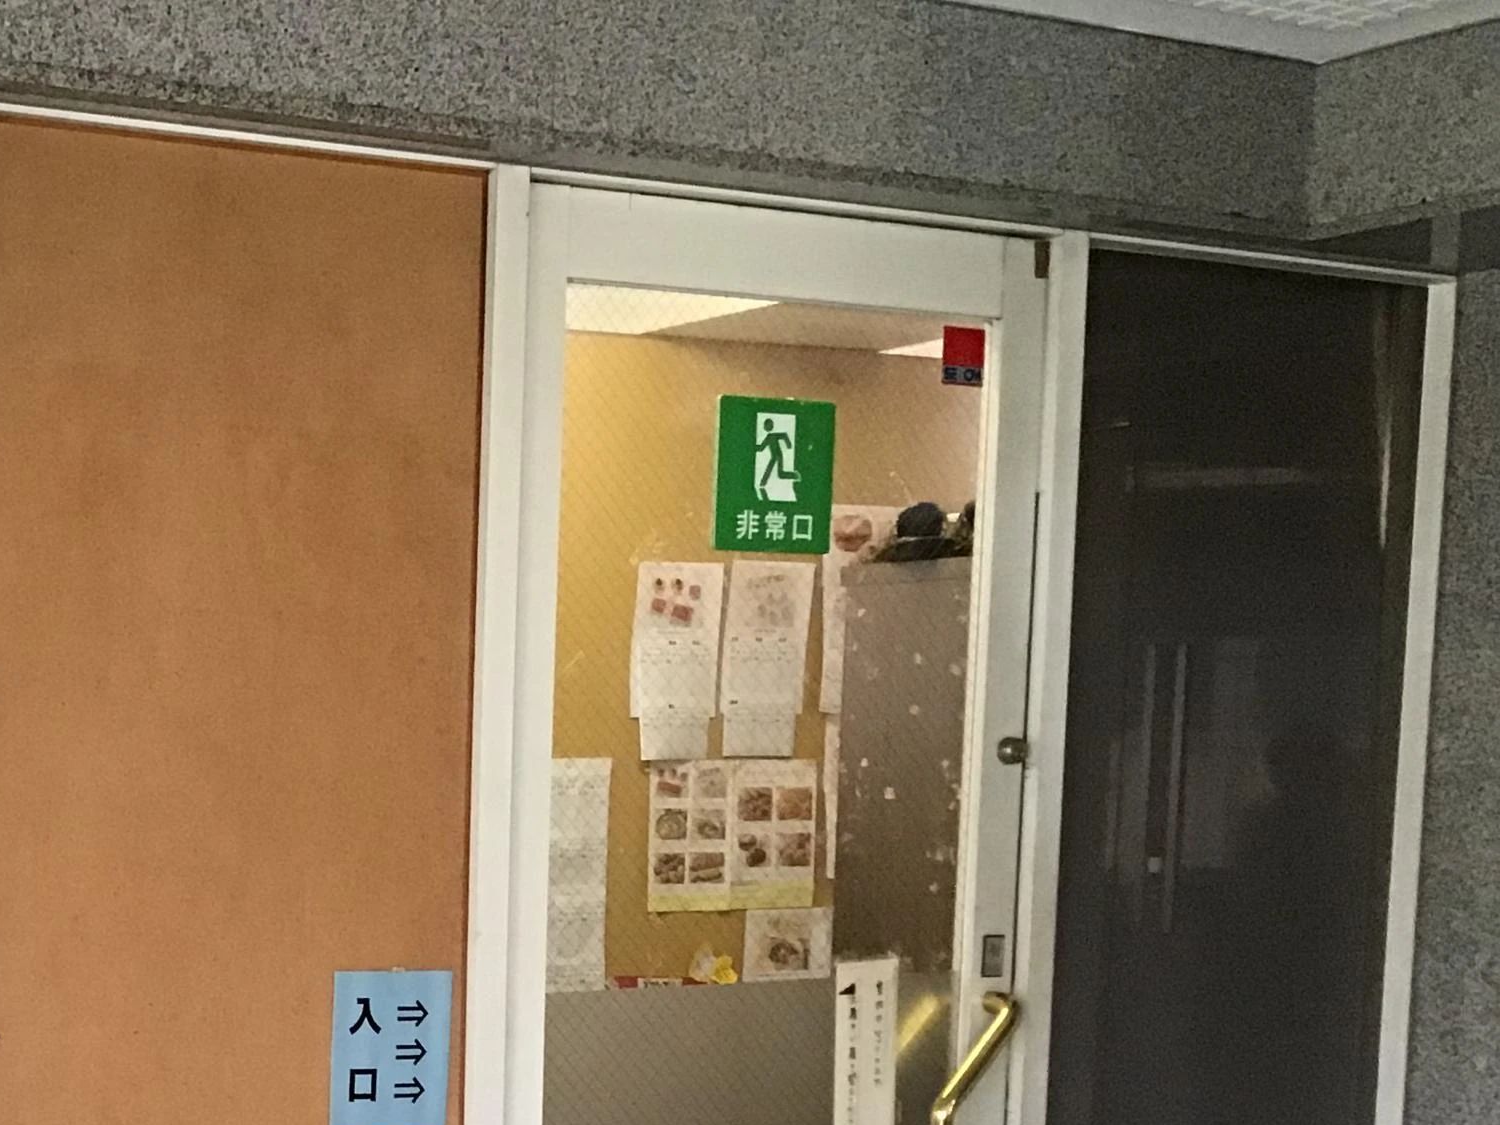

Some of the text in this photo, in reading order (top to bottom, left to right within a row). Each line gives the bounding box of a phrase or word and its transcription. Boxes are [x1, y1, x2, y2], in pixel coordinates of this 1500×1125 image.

[736, 509, 813, 541] 非常口
[348, 997, 382, 1102] 入口
